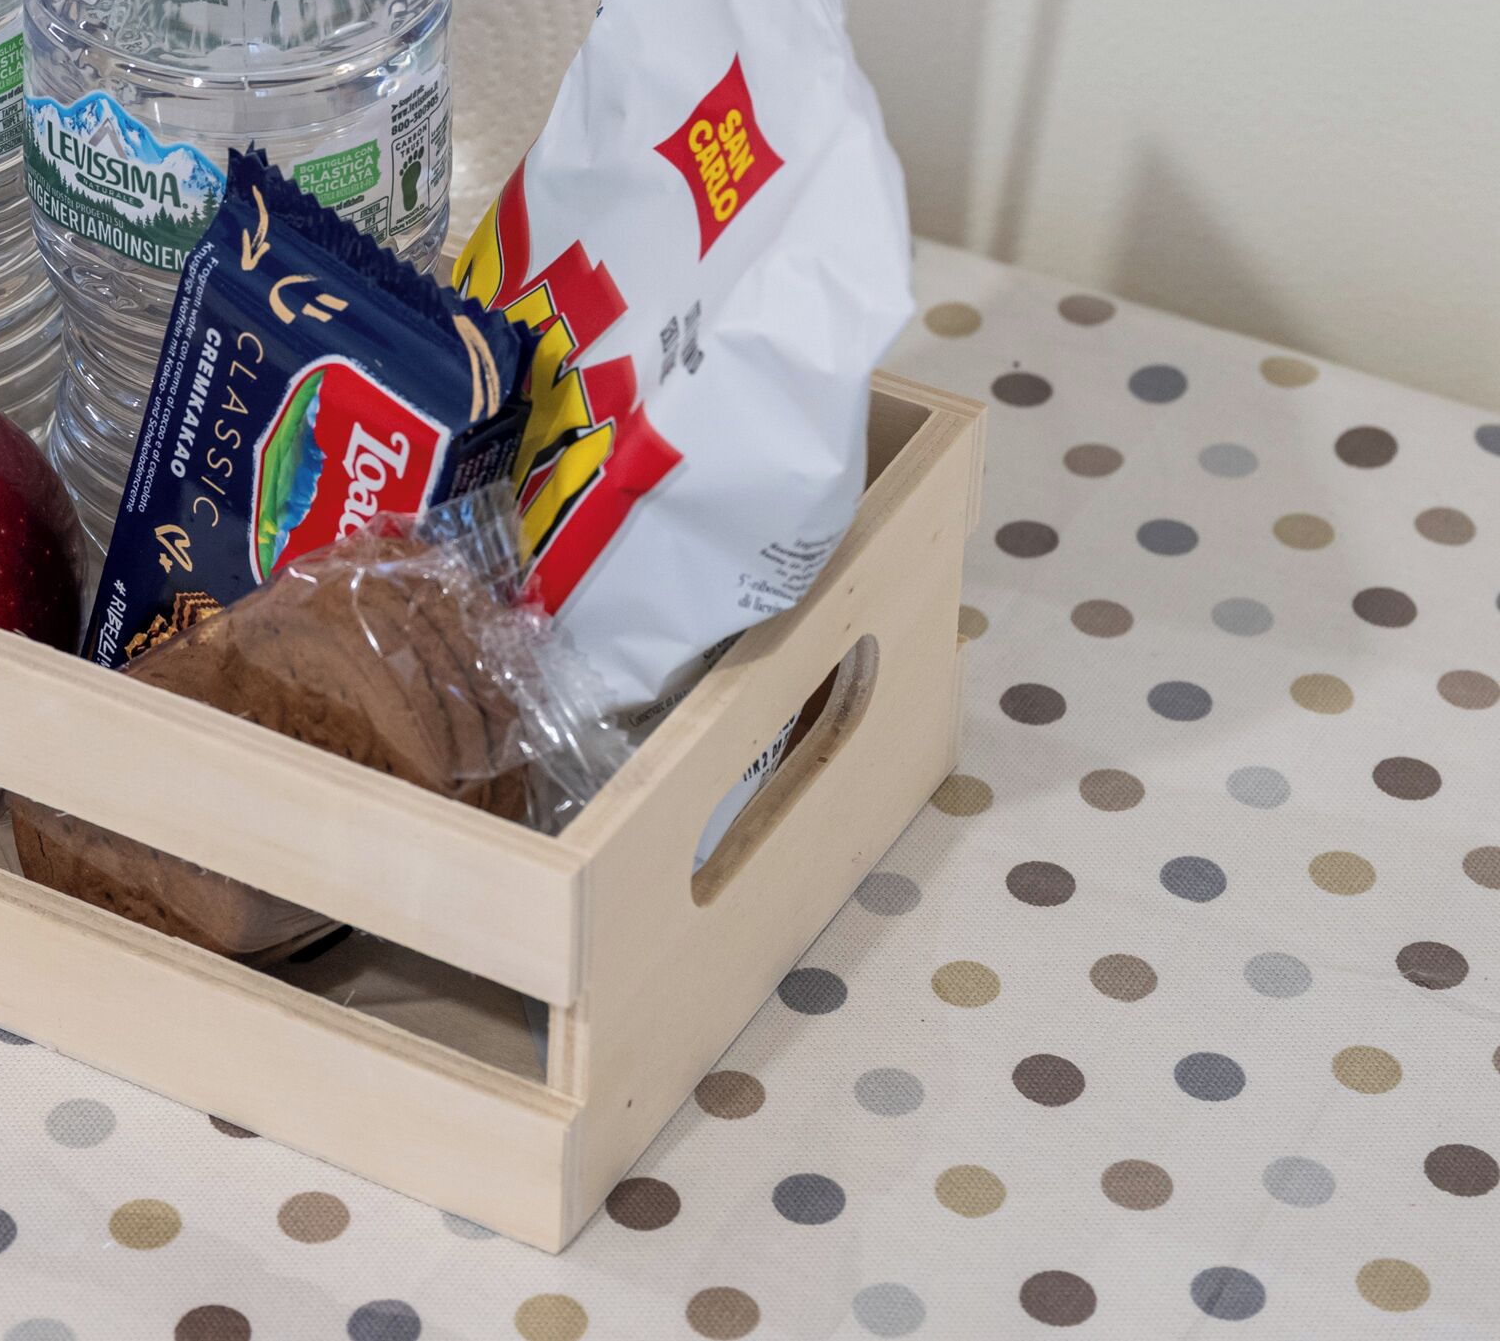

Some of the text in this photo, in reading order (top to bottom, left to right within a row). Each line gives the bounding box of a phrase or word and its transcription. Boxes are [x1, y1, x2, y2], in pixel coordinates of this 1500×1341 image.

[300, 145, 373, 174] BOTTIGLIA CON
[395, 123, 427, 151] CARBON
[400, 136, 424, 158] TRUST
[718, 109, 755, 182] SAN
[47, 120, 182, 209] LEVISSIMA
[299, 155, 373, 186] PLASTICA
[688, 119, 739, 222] CARLO
[51, 187, 75, 209] NOSTRI
[75, 199, 113, 225] PROGETTI
[113, 216, 125, 229] SU
[82, 177, 135, 205] NATURALE
[27, 172, 193, 271] RIGENERIAMOINSIEM
[196, 257, 219, 309] Fragranti
[188, 309, 199, 340] wafer
[181, 340, 191, 358] con
[126, 241, 215, 513] Knusprige Waffeln mit Kakao- und Schokoladencreme
[171, 358, 185, 396] crema
[157, 407, 171, 441] cacao
[170, 327, 221, 478] CREMKAKAO
[193, 331, 264, 527] CLASSIC
[138, 461, 156, 513] cioccolato
[335, 421, 411, 541] Loac
